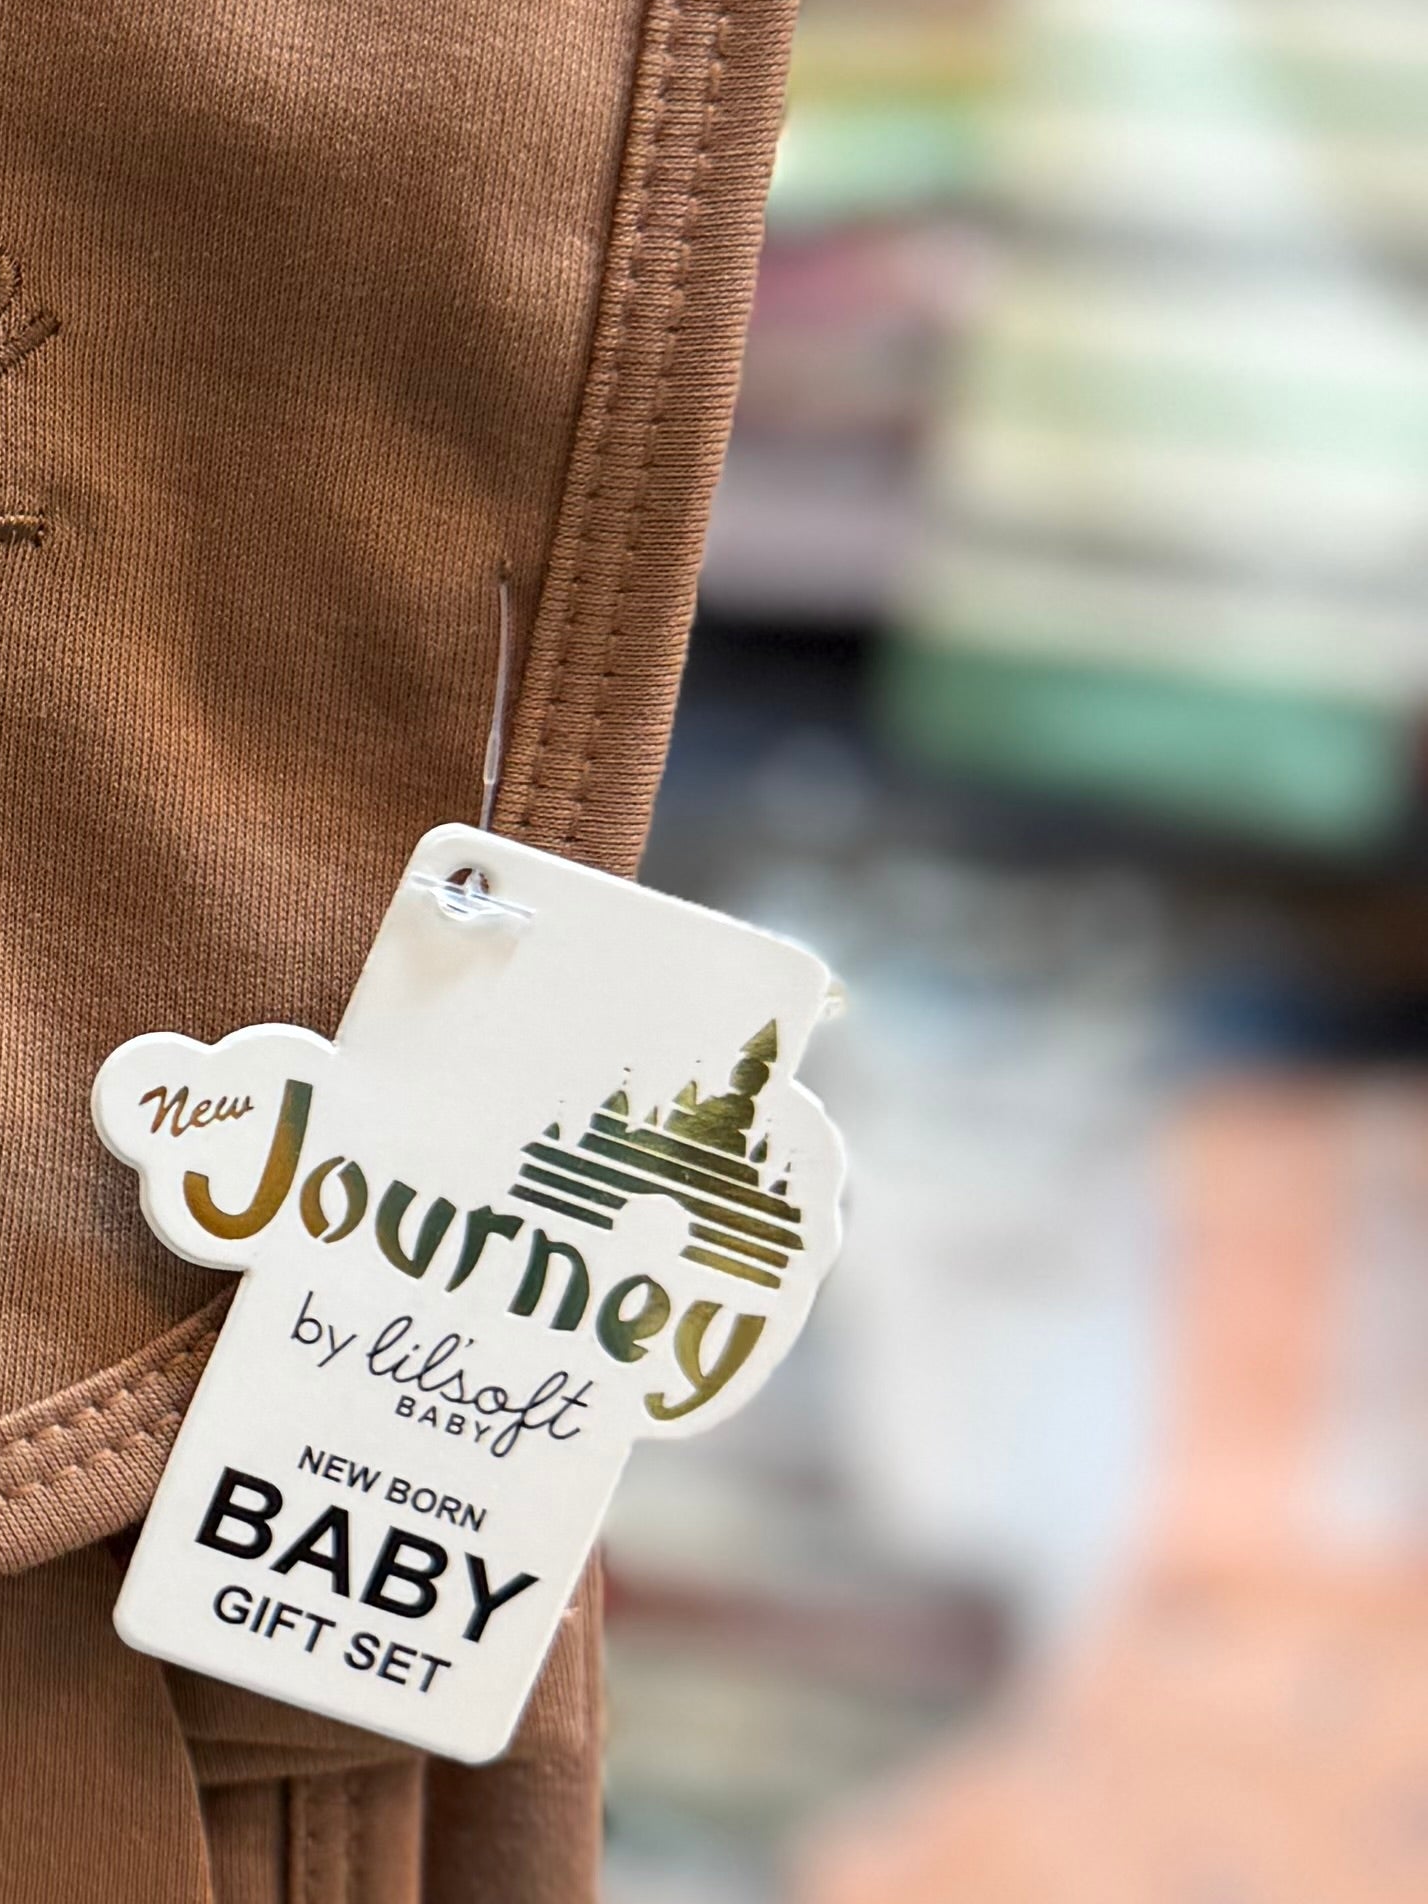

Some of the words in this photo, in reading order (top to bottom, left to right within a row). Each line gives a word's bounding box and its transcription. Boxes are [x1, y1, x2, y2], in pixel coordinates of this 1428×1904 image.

[138, 1085, 254, 1138] New
[182, 1079, 766, 1422] Journey
[290, 1292, 357, 1367] by
[394, 1396, 492, 1445] BABY
[297, 1445, 381, 1493] NEW
[384, 1477, 488, 1532] BORN
[194, 1465, 541, 1644] BABY
[212, 1584, 337, 1655] GIFT
[343, 1631, 453, 1695] SET
